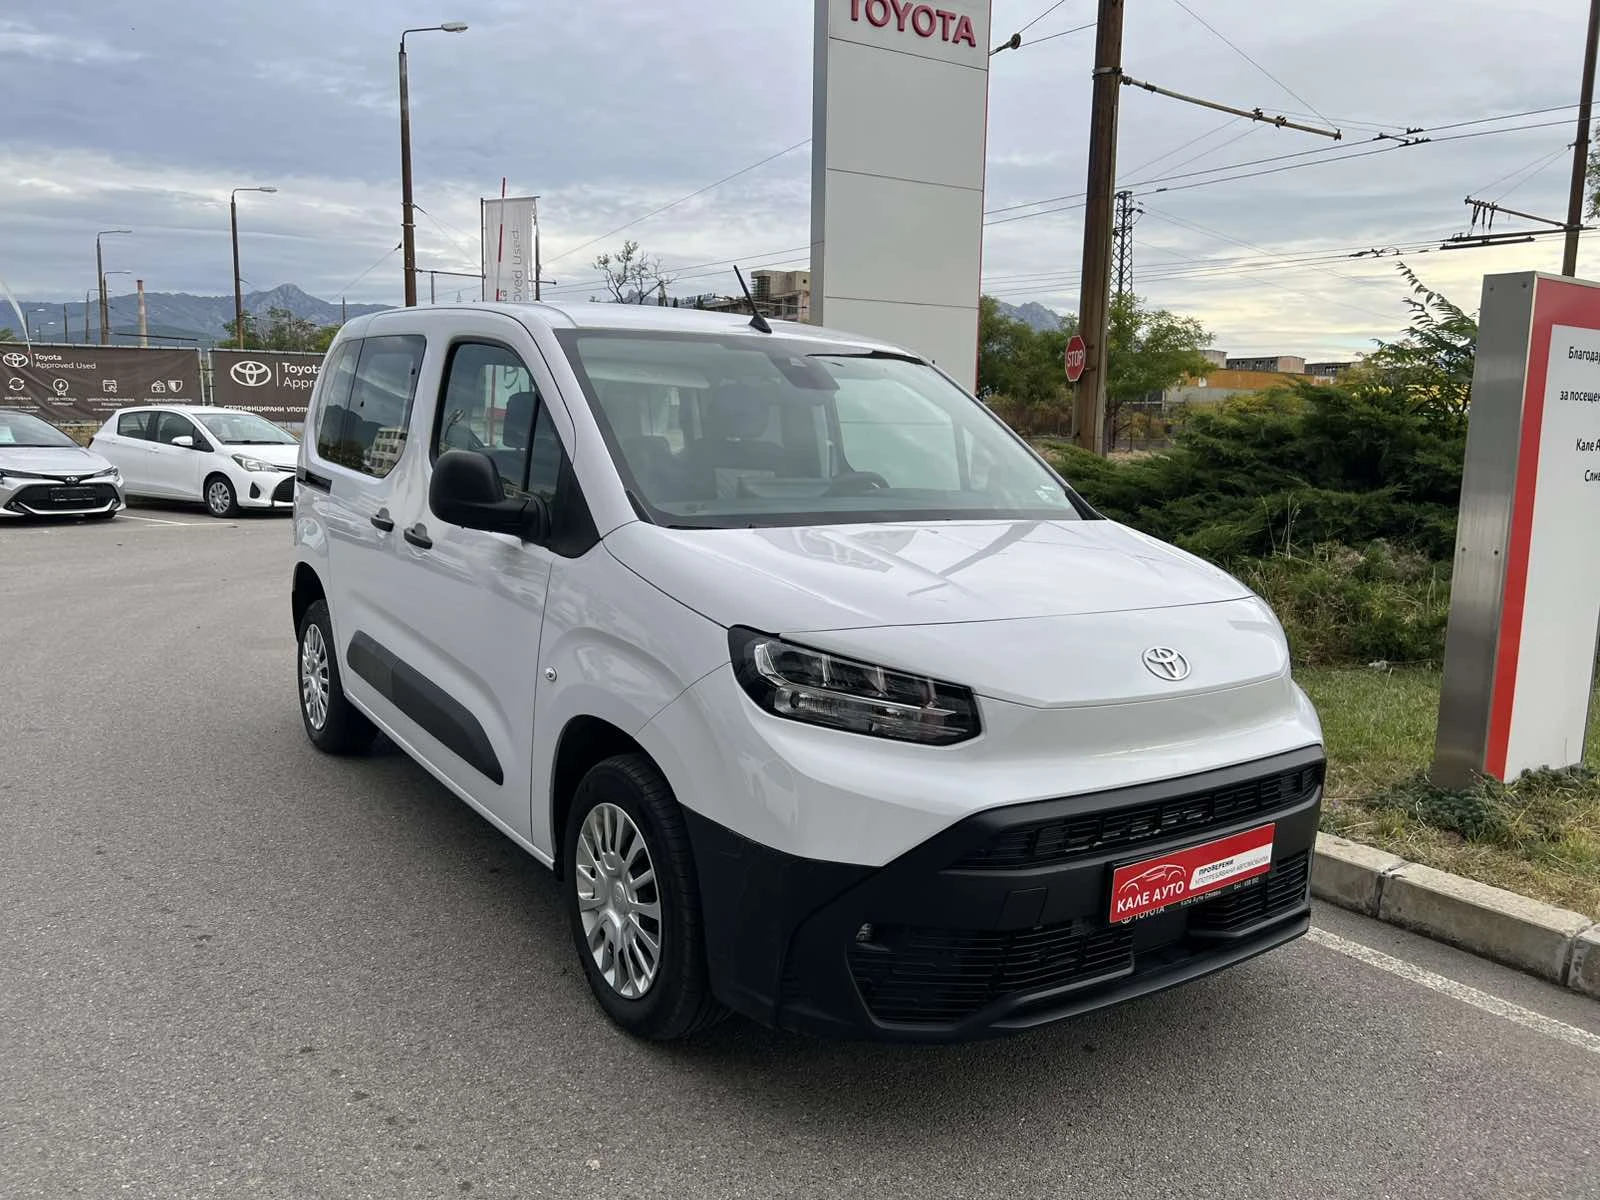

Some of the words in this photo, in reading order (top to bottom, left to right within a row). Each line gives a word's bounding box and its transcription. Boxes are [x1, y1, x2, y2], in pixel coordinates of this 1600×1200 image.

[850, 0, 977, 48] TOYOTA
[34, 353, 62, 362] Toyota
[1067, 350, 1083, 367] STOP
[35, 362, 74, 370] Approved
[76, 362, 96, 370] Used
[283, 377, 316, 390] Appr
[1560, 390, 1568, 401] за
[1576, 438, 1594, 452] Кале
[1198, 859, 1234, 876] ПРОВЕРЕНИ
[1117, 891, 1150, 913] КАЛЕ
[1153, 881, 1184, 902] АУТО
